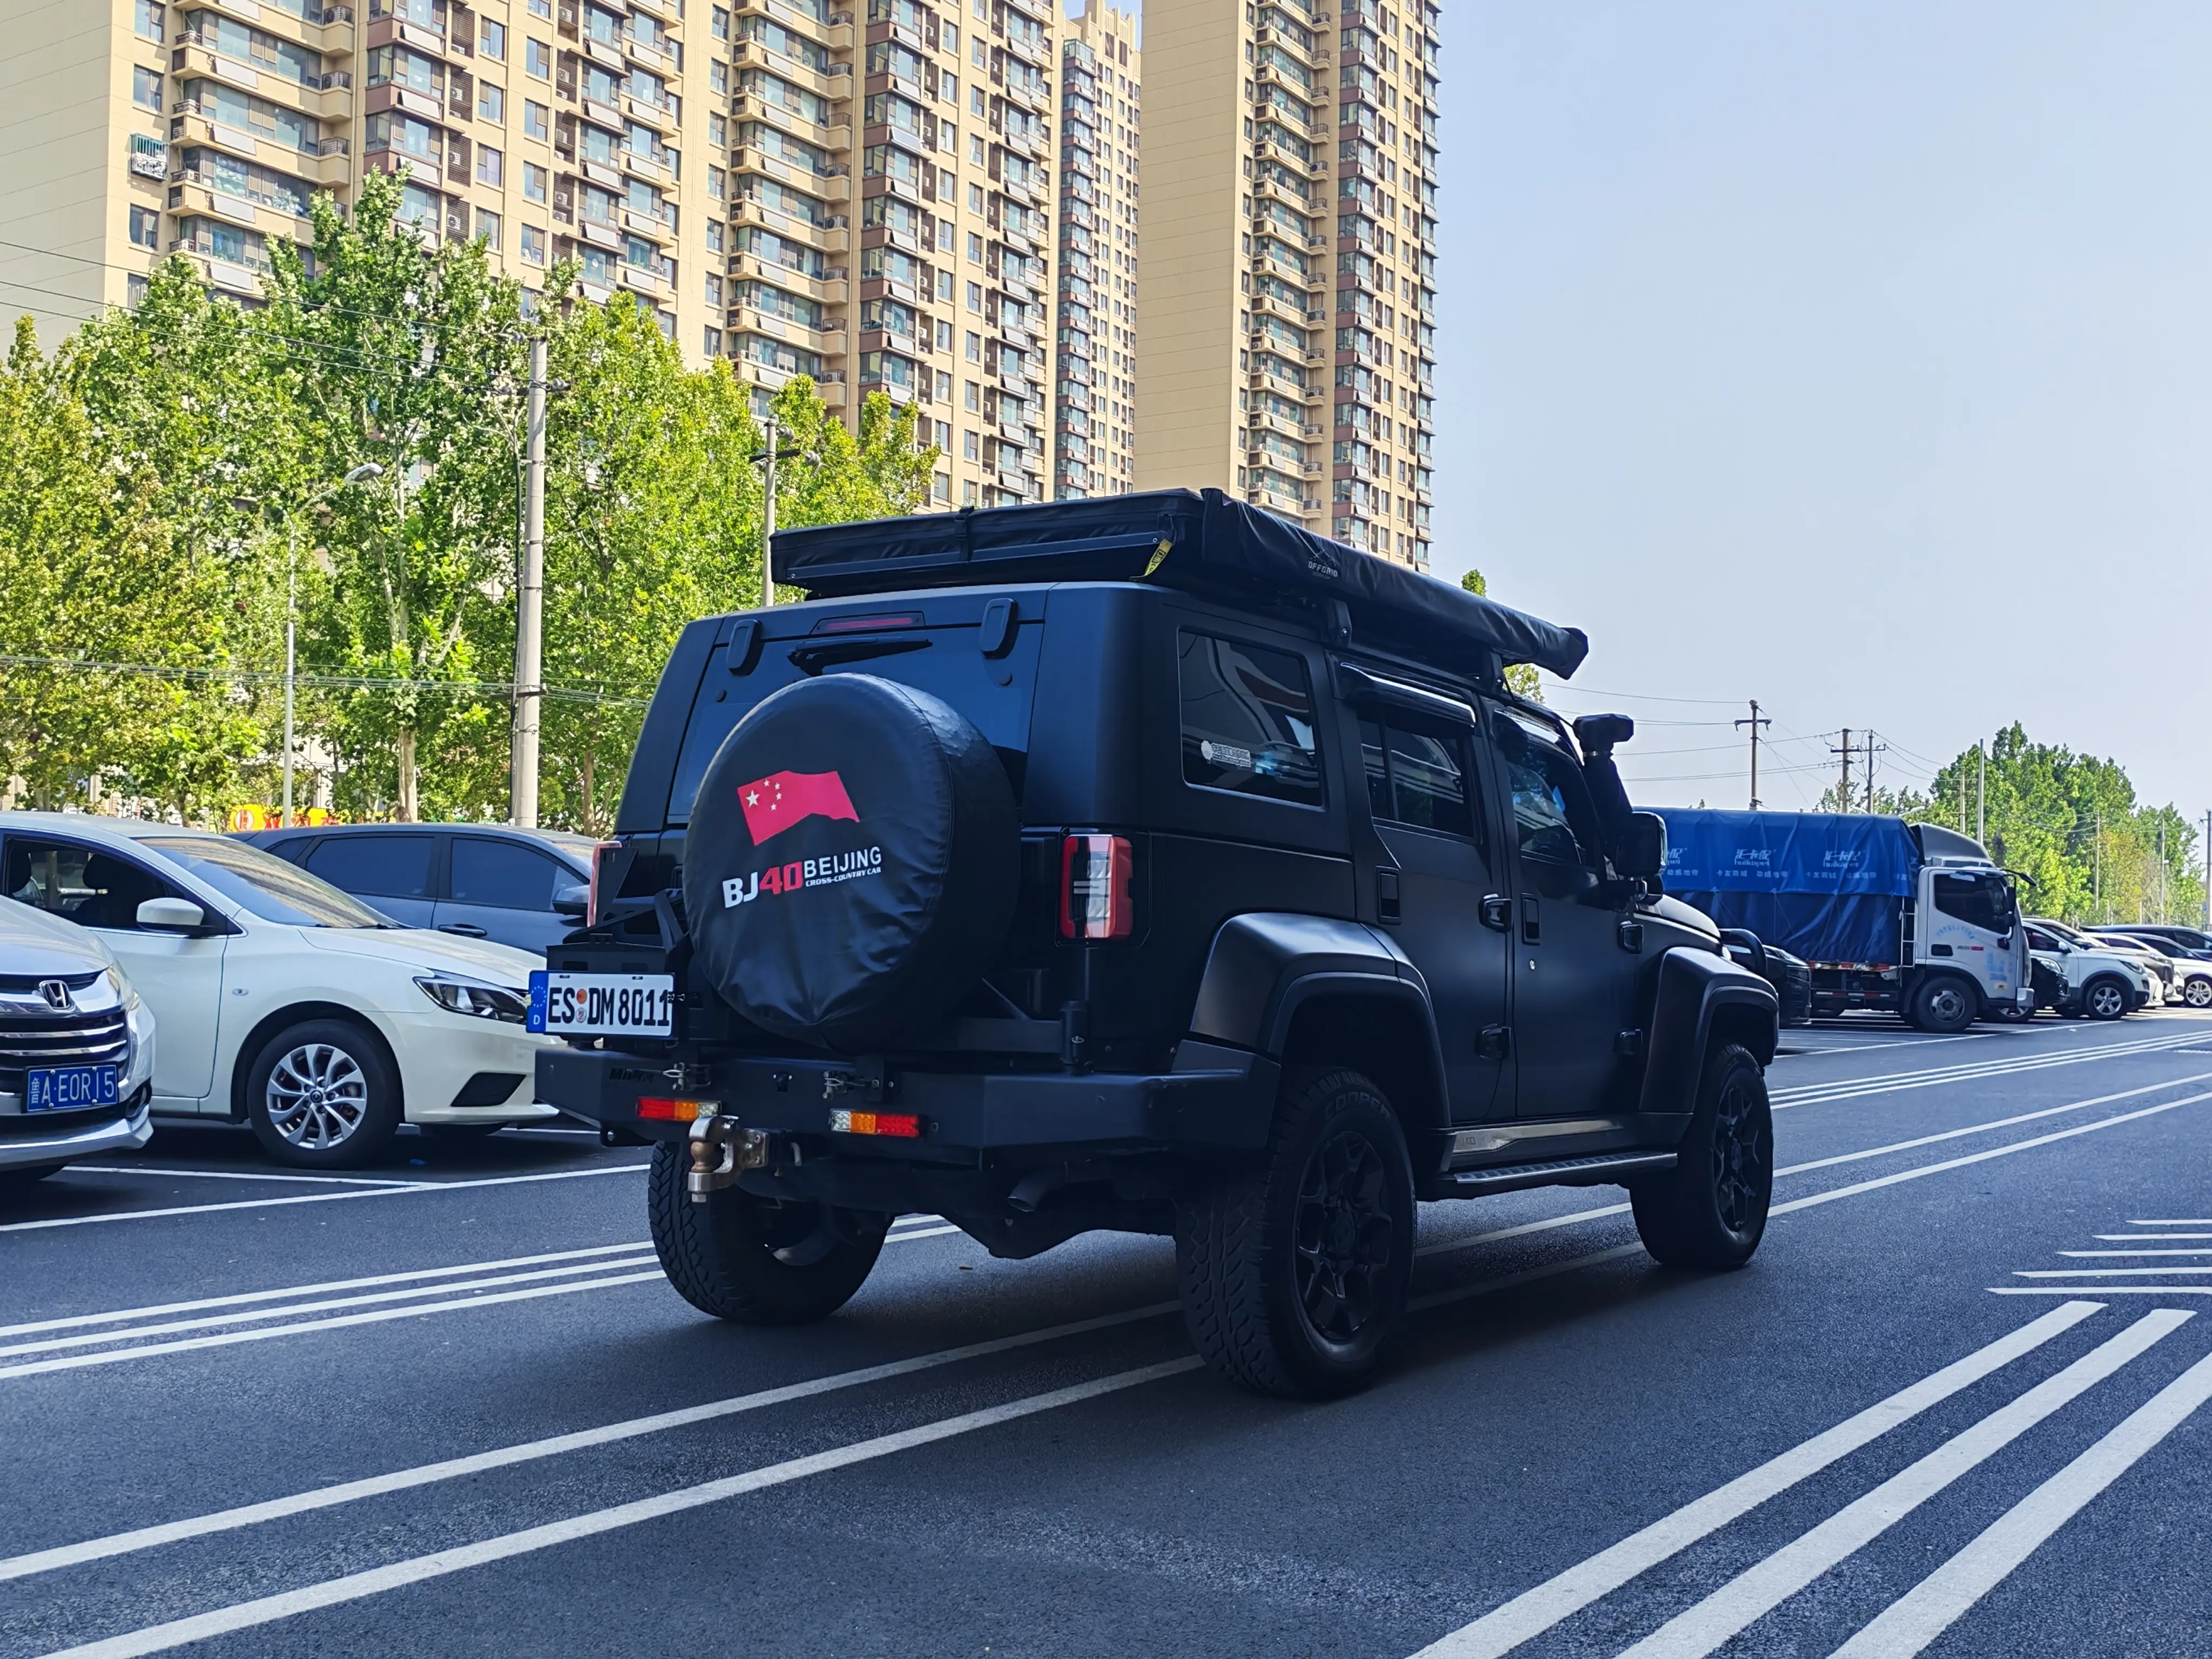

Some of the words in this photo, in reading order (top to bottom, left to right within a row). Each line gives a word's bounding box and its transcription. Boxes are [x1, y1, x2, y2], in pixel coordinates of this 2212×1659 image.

[1308, 561, 1338, 577] OFFGRID
[723, 861, 803, 908] BJ40
[804, 846, 882, 878] BEIJING
[867, 866, 882, 875] CAR
[548, 987, 575, 1024] ES
[533, 1014, 541, 1025] D
